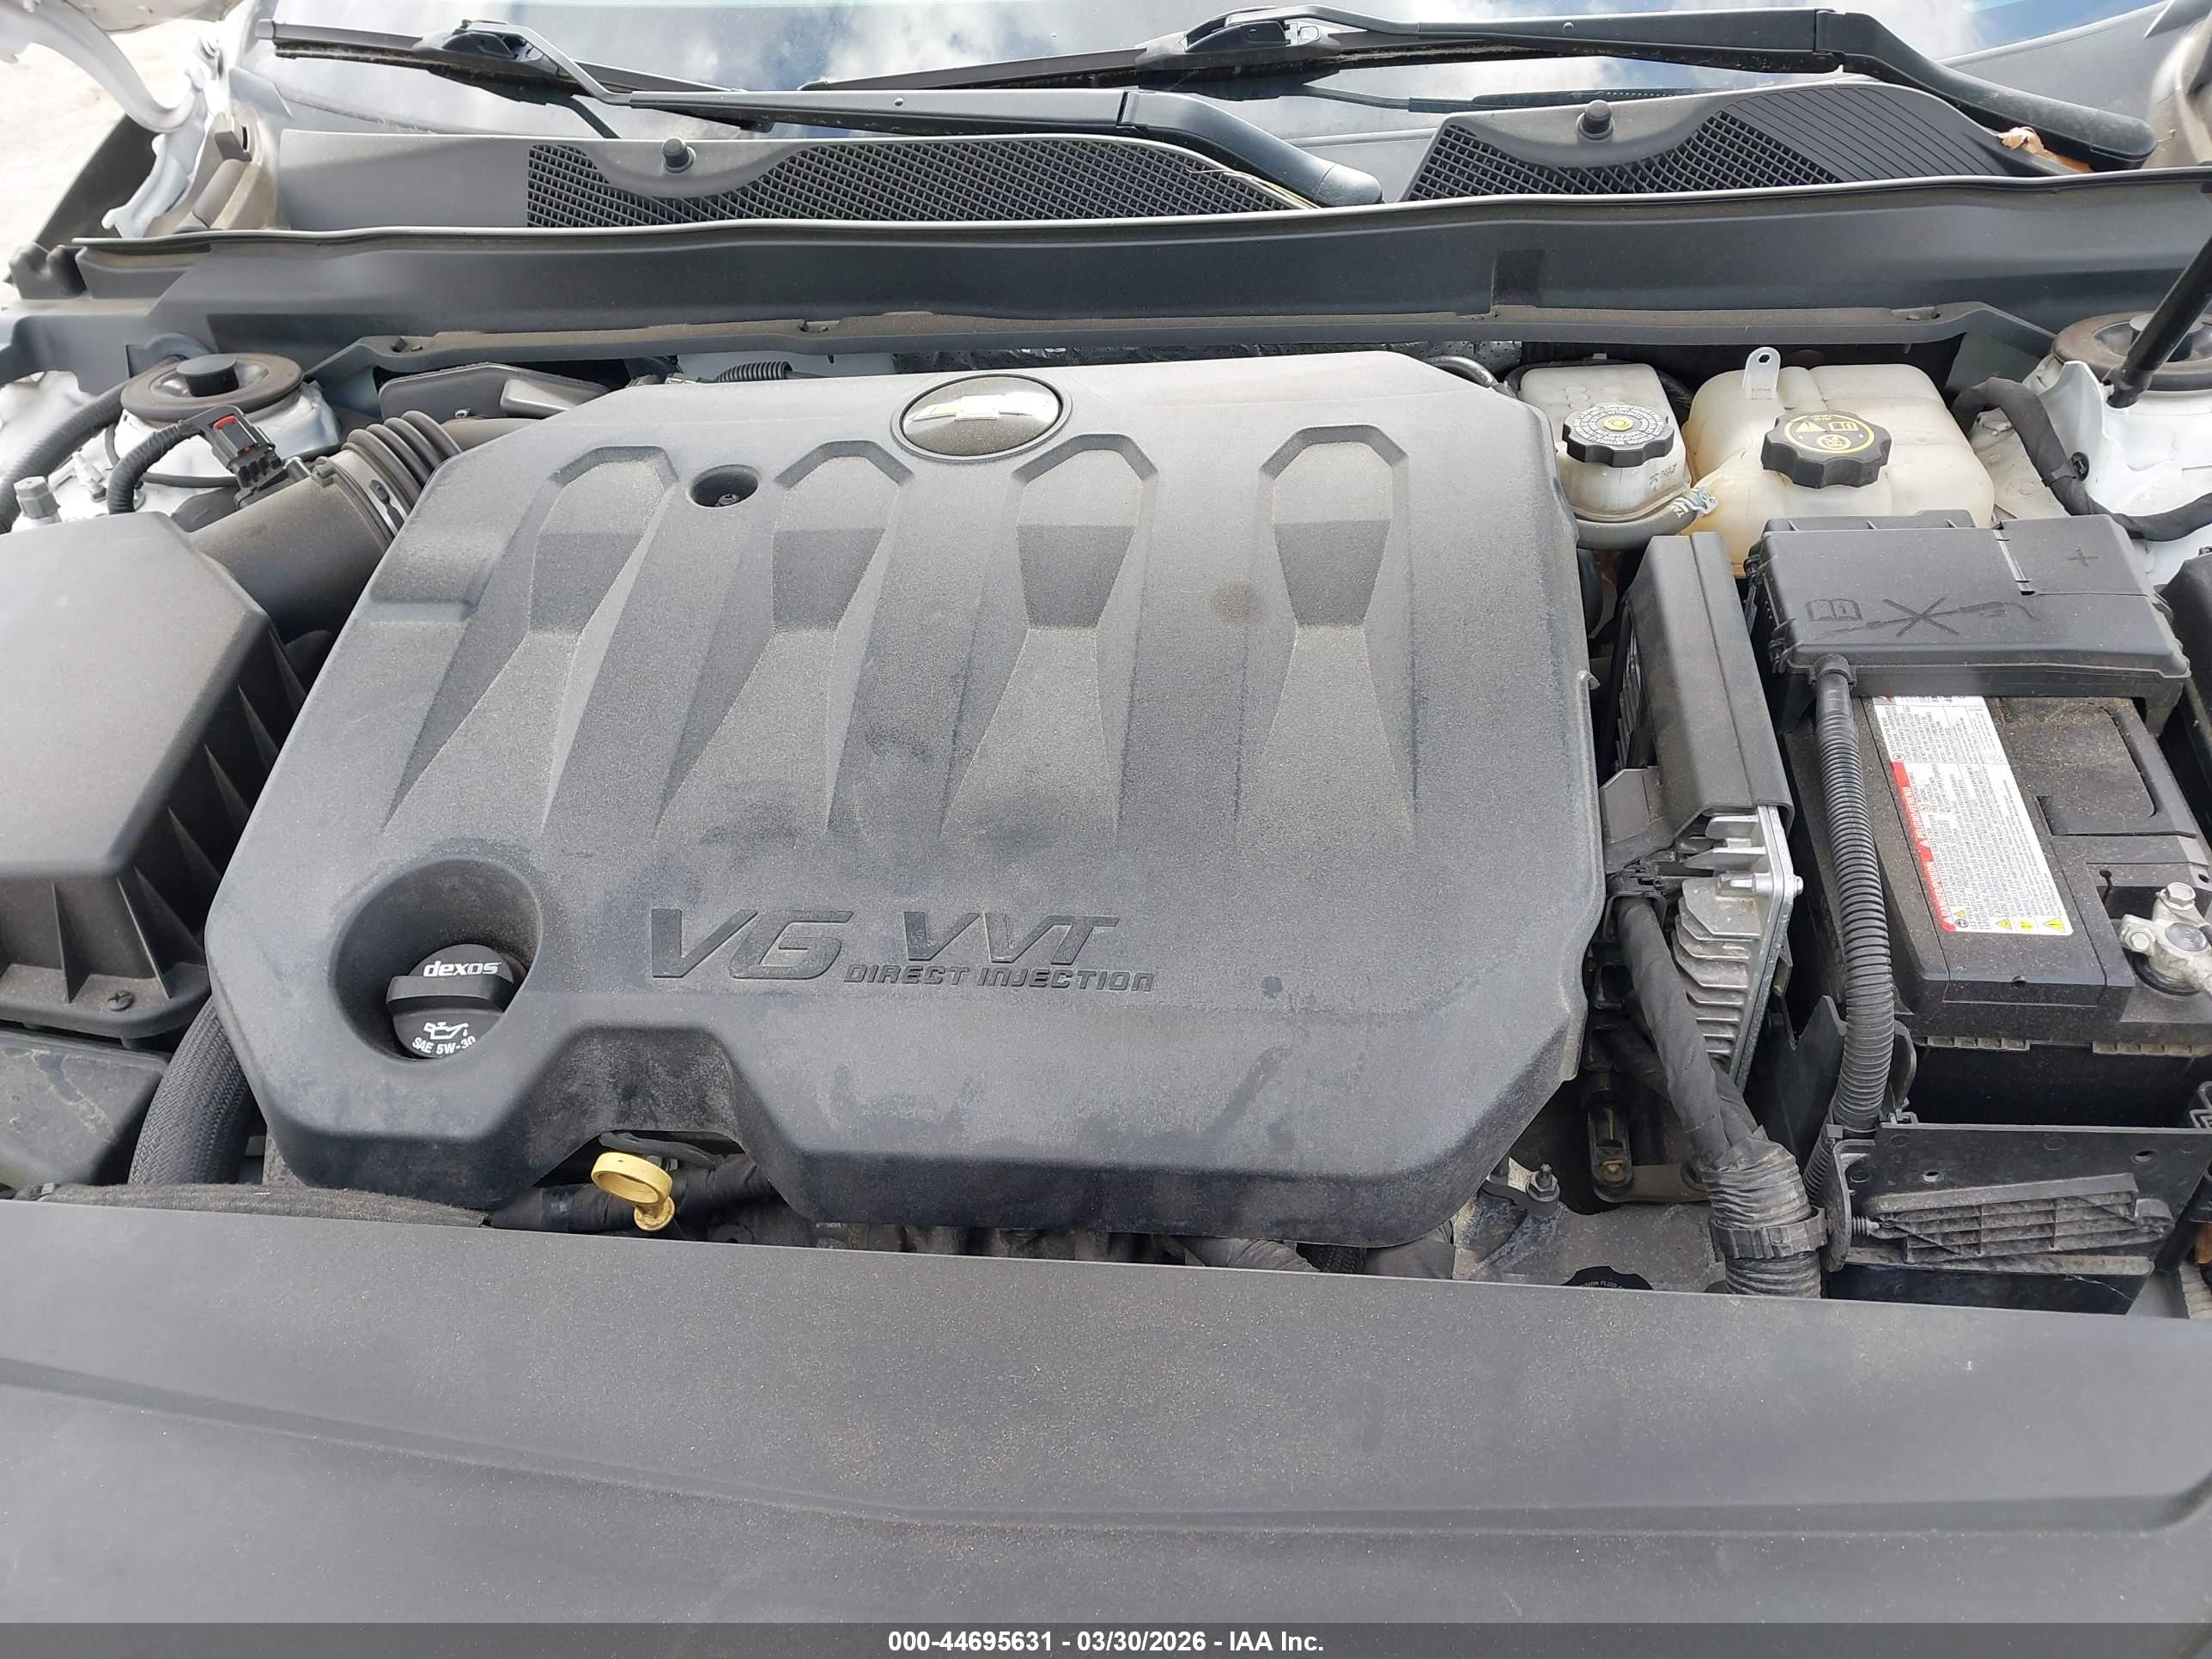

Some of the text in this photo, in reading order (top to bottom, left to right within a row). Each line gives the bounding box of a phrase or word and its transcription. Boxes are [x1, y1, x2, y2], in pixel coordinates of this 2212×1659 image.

[1900, 786, 1927, 838] PELIGRO/VENENO
[1924, 861, 1952, 916] DANGER/POISON
[650, 908, 1120, 980] V6 VVT
[422, 960, 500, 977] dexos
[843, 963, 1155, 992] DIRECT INJECTION
[412, 1036, 434, 1054] SAE
